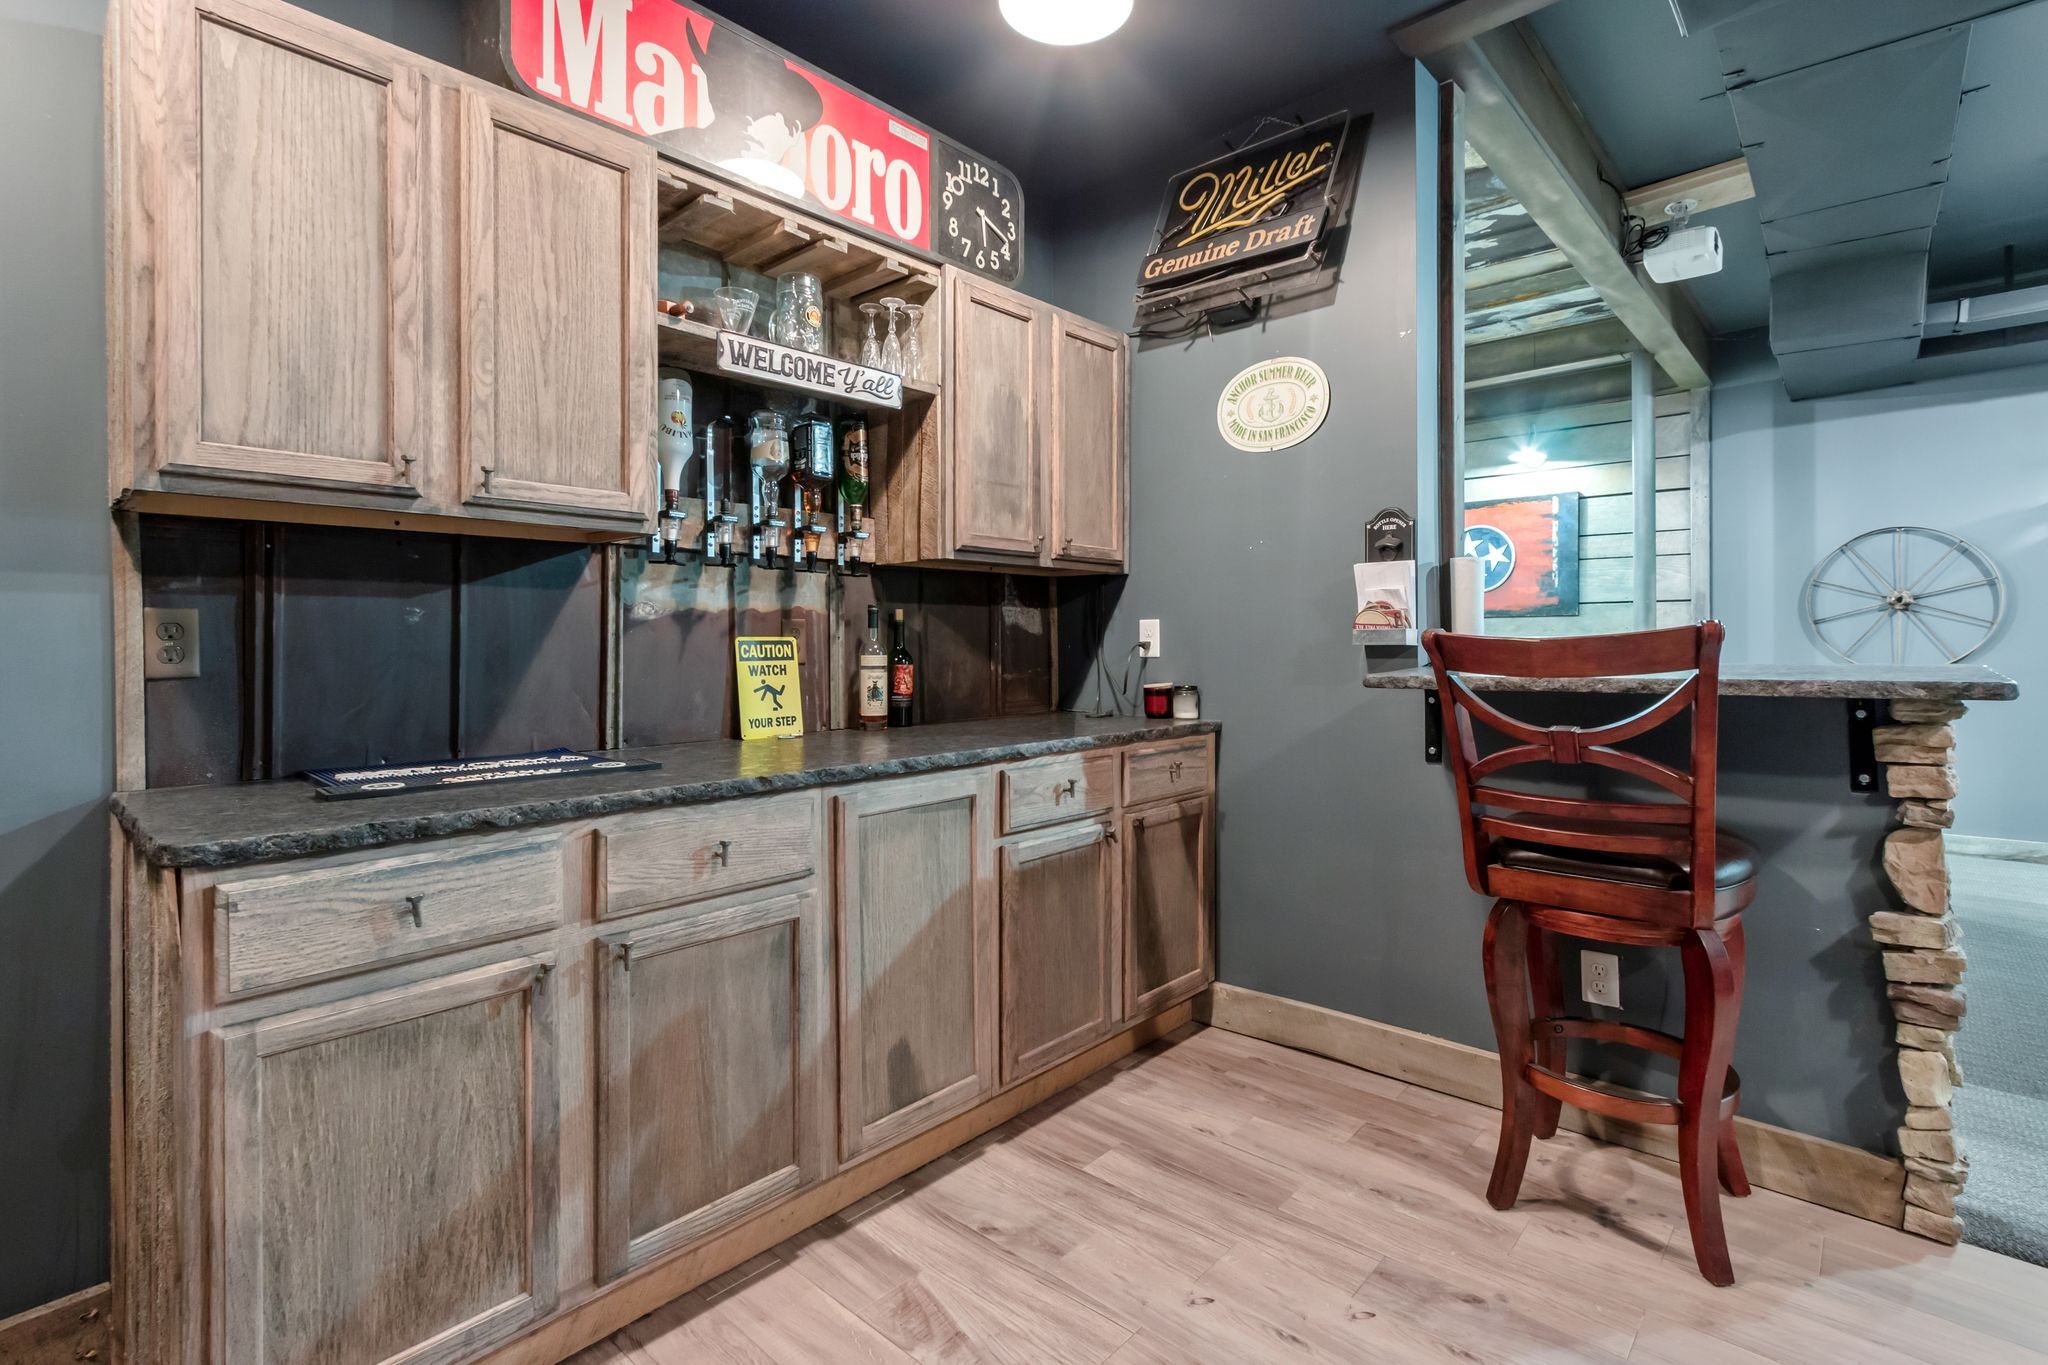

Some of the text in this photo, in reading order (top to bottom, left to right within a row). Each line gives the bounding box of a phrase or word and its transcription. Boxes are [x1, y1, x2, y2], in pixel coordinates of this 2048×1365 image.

[958, 160, 972, 184] 11
[973, 162, 989, 187] 12
[945, 171, 964, 196] 10
[992, 177, 999, 198] 1
[1179, 142, 1332, 234] Miller
[942, 191, 953, 210] 9
[1001, 198, 1010, 218] 2
[948, 217, 958, 237] 8
[1007, 221, 1016, 241] 3
[961, 237, 971, 257] 7
[1000, 242, 1010, 262] 4
[1144, 213, 1316, 279] Genuine Draft
[975, 250, 985, 269] 6
[990, 250, 999, 270] 5
[728, 339, 895, 400] WELCOME Y'all
[1226, 365, 1317, 406] ANCHOR SUMMER BEER
[1228, 405, 1316, 442] MADE IN SAN FRANCISCO
[1372, 517, 1390, 530] BOTTLE
[740, 644, 792, 658] CAUTION
[748, 664, 788, 677] WATCH
[748, 715, 797, 729] YOUR STEP
